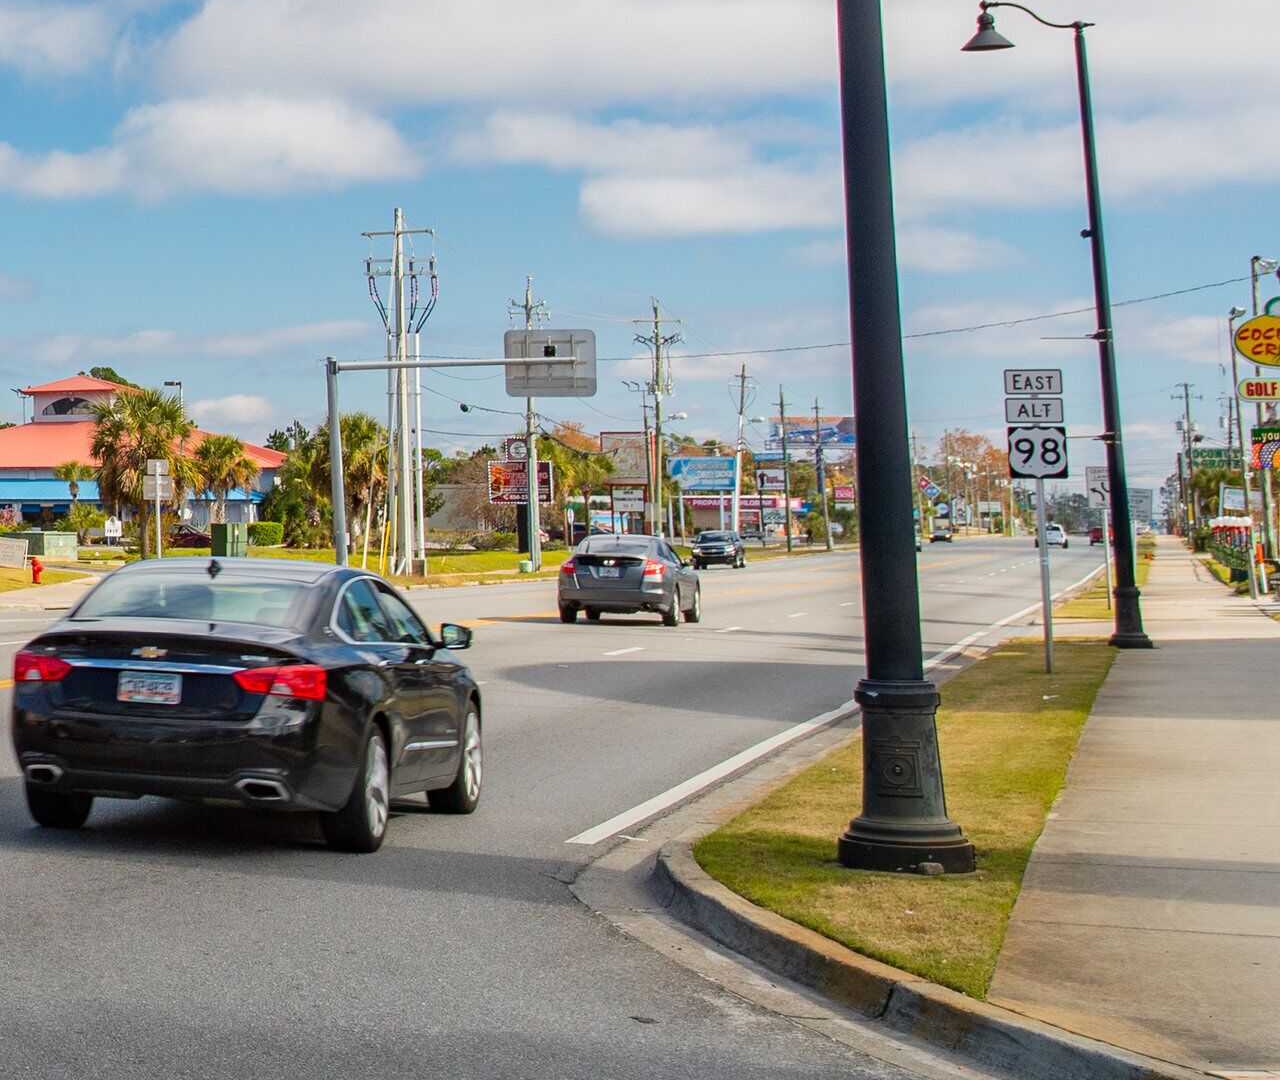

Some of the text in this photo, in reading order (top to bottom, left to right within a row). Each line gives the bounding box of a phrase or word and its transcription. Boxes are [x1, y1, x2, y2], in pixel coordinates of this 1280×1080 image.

[1012, 374, 1054, 391] EAST
[1245, 382, 1278, 397] GOLF
[1017, 403, 1052, 418] ALT
[1014, 438, 1061, 465] 98
